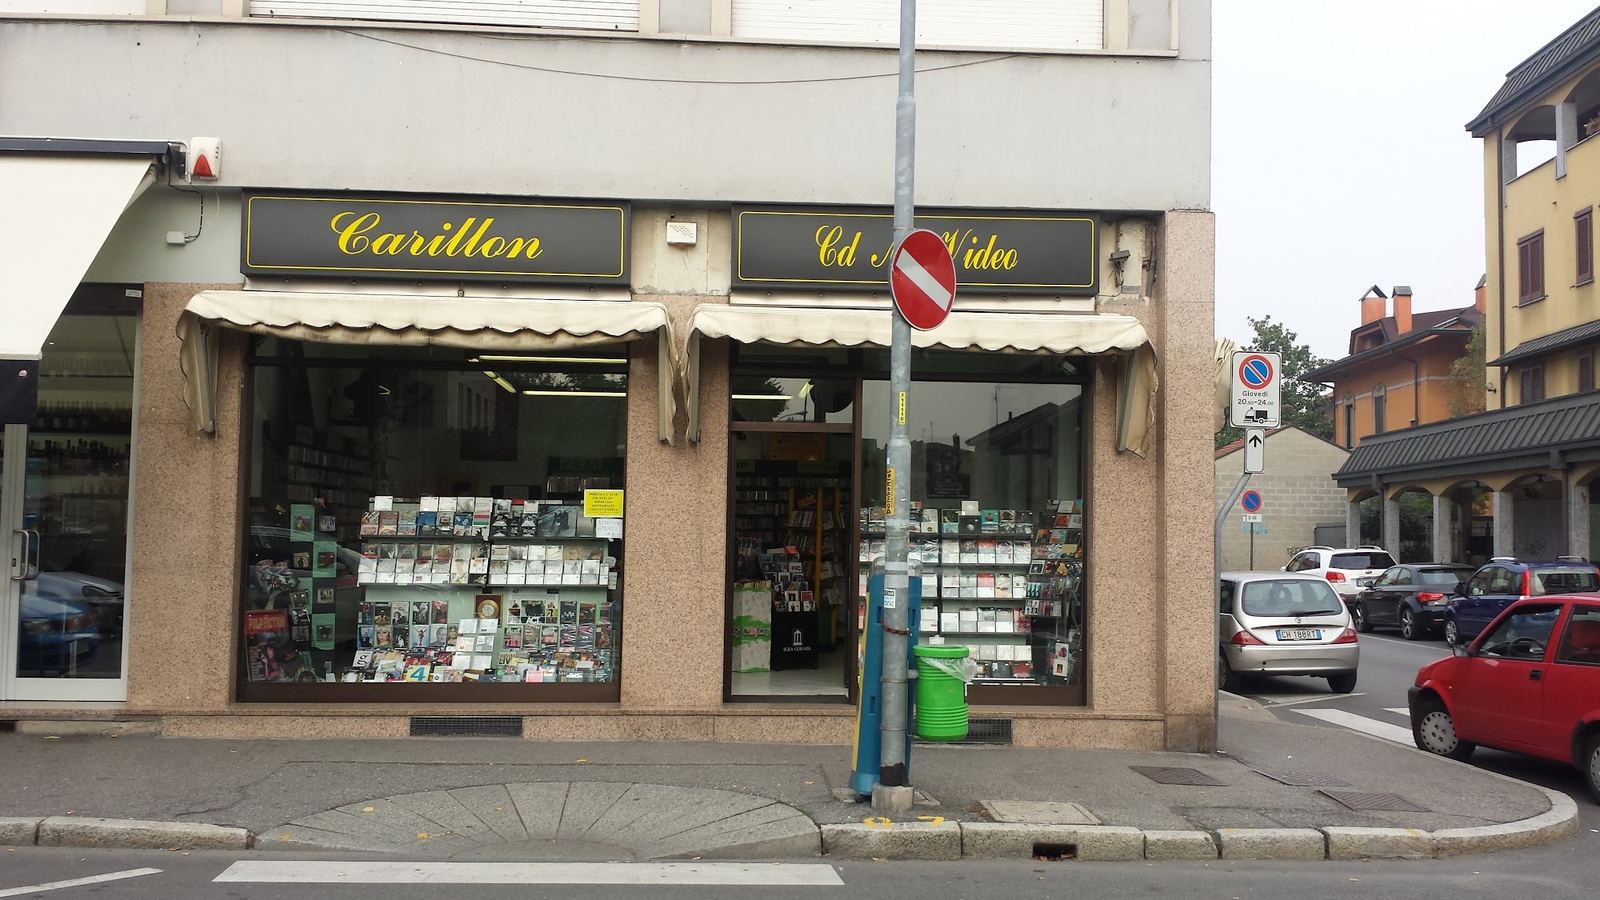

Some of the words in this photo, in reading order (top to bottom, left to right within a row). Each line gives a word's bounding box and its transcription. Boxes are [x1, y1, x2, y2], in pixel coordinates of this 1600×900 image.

[329, 211, 543, 260] Carillon
[815, 225, 862, 267] Cd
[410, 667, 426, 681] 4
